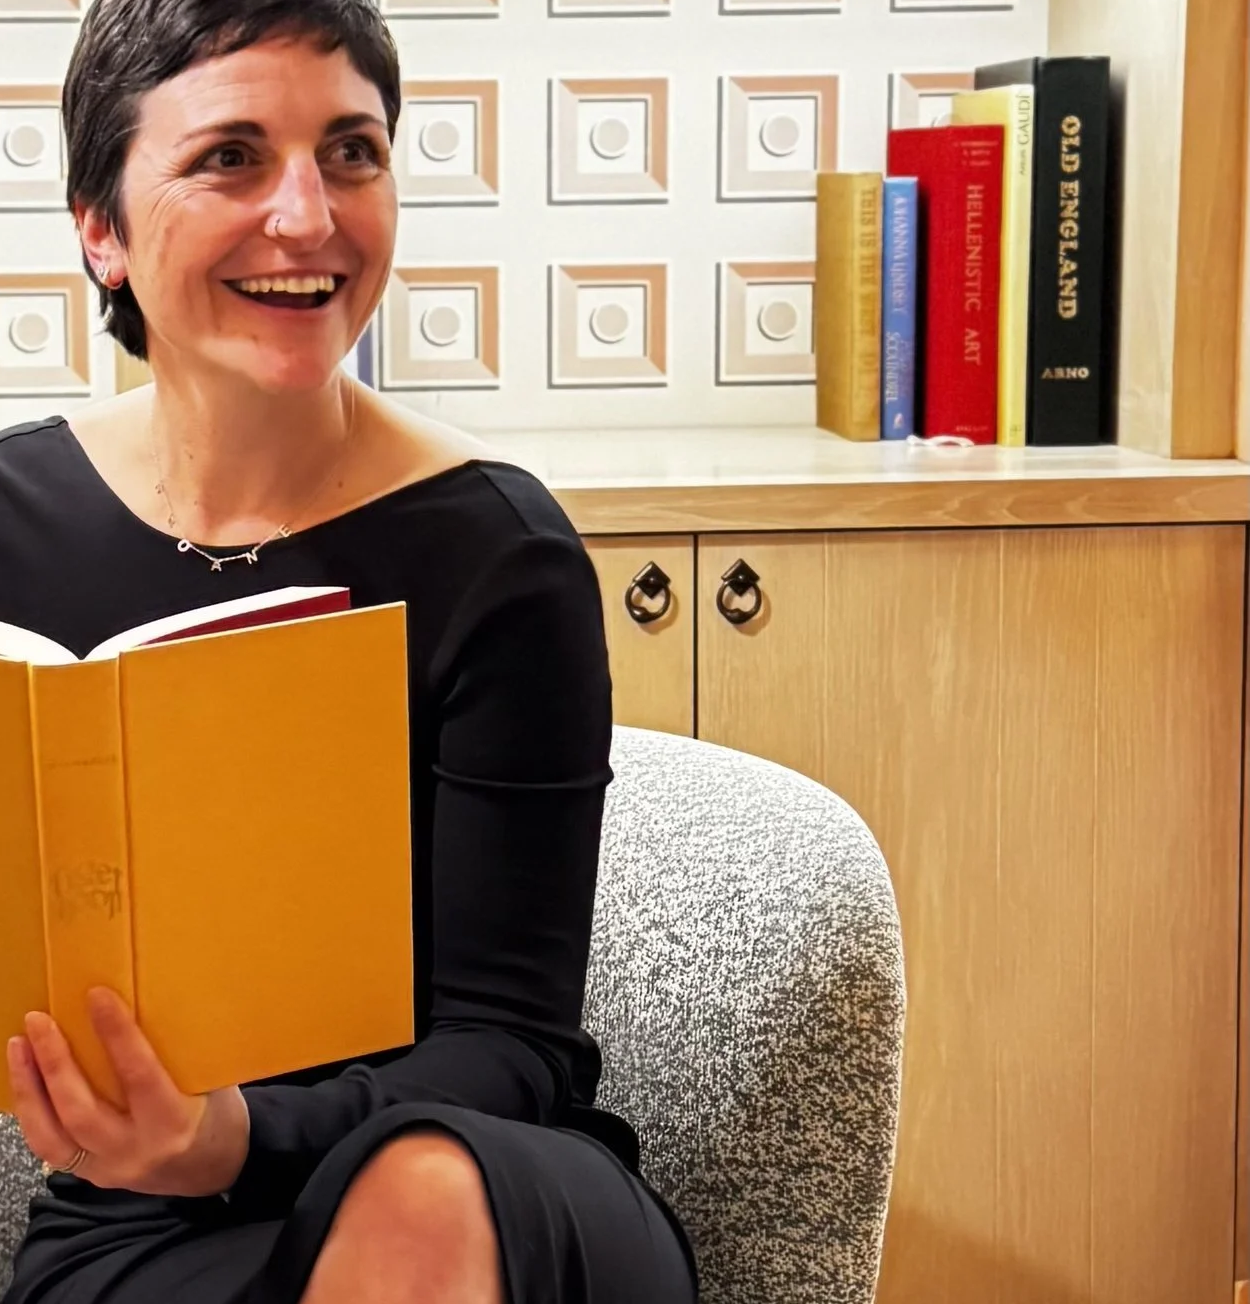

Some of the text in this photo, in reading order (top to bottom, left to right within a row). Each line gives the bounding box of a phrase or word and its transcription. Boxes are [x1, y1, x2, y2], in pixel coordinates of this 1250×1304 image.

[860, 188, 877, 226] THIS
[1056, 115, 1082, 319] OLD ENGLAND
[860, 232, 876, 248] IS
[860, 253, 876, 286] THE
[964, 184, 984, 365] HELLENISTIC ART
[1041, 366, 1090, 380] ARNO
